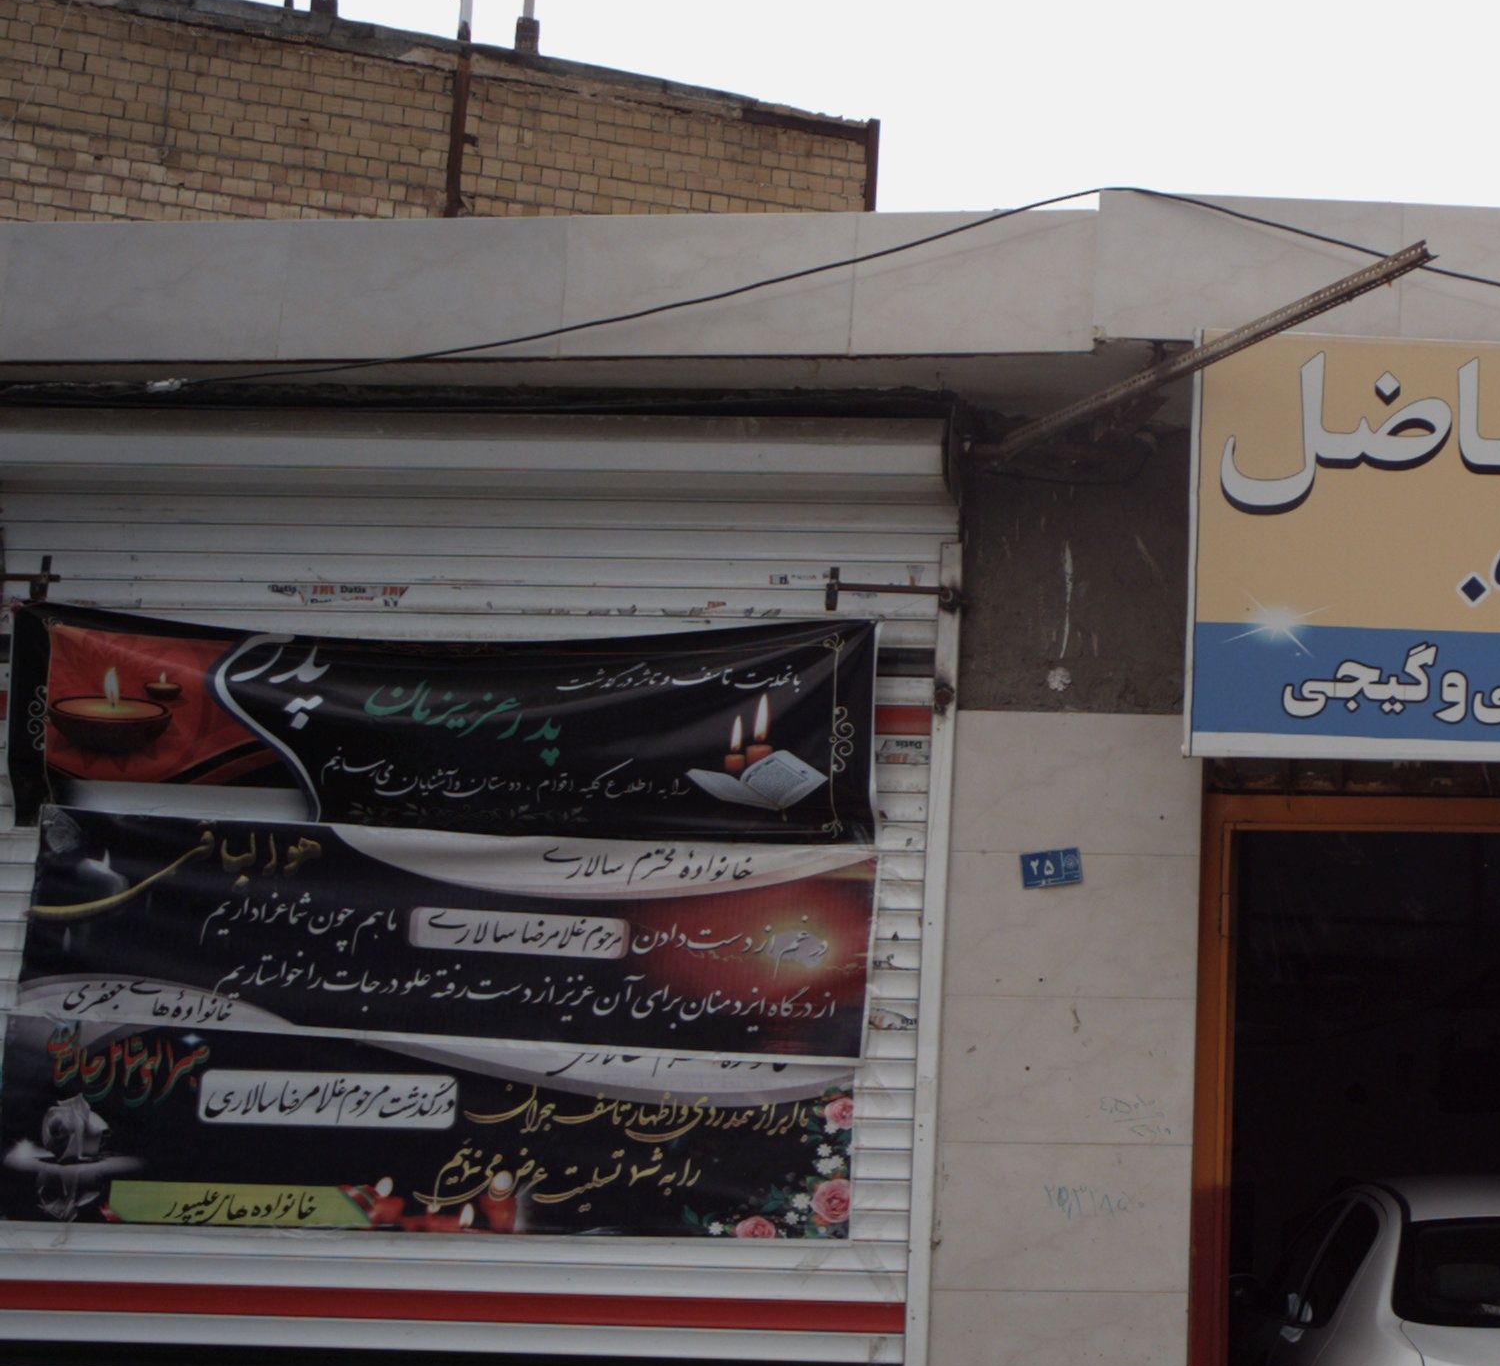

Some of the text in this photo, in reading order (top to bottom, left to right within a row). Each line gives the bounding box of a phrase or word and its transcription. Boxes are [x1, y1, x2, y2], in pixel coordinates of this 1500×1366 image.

[670, 666, 734, 686] تاسف
[1283, 642, 1437, 718] گیجی
[363, 678, 521, 739] عزیزمان
[1434, 670, 1469, 722] و
[442, 776, 521, 797] دوستان
[578, 758, 634, 799] کلیه
[604, 779, 652, 799] اطلاع
[627, 847, 676, 886] محترم
[1029, 858, 1056, 876] ۲۵
[307, 907, 356, 952] چون
[582, 924, 622, 952] مرحوم
[630, 922, 688, 956] دادن
[687, 929, 753, 954] دست
[773, 914, 809, 981] غم
[62, 982, 127, 1015] جعفری
[322, 968, 400, 1013] درجات
[554, 974, 595, 1022] عزیز
[592, 973, 647, 1017] آن
[630, 983, 683, 1030] برای
[679, 989, 731, 1021] منان
[731, 986, 766, 1033] ایزد
[767, 985, 813, 1019] درگاه
[205, 1080, 279, 1118] سالاری
[336, 1084, 390, 1124] مرحوم
[531, 1148, 626, 1213] تسلیت
[250, 1190, 317, 1220] خانواده
